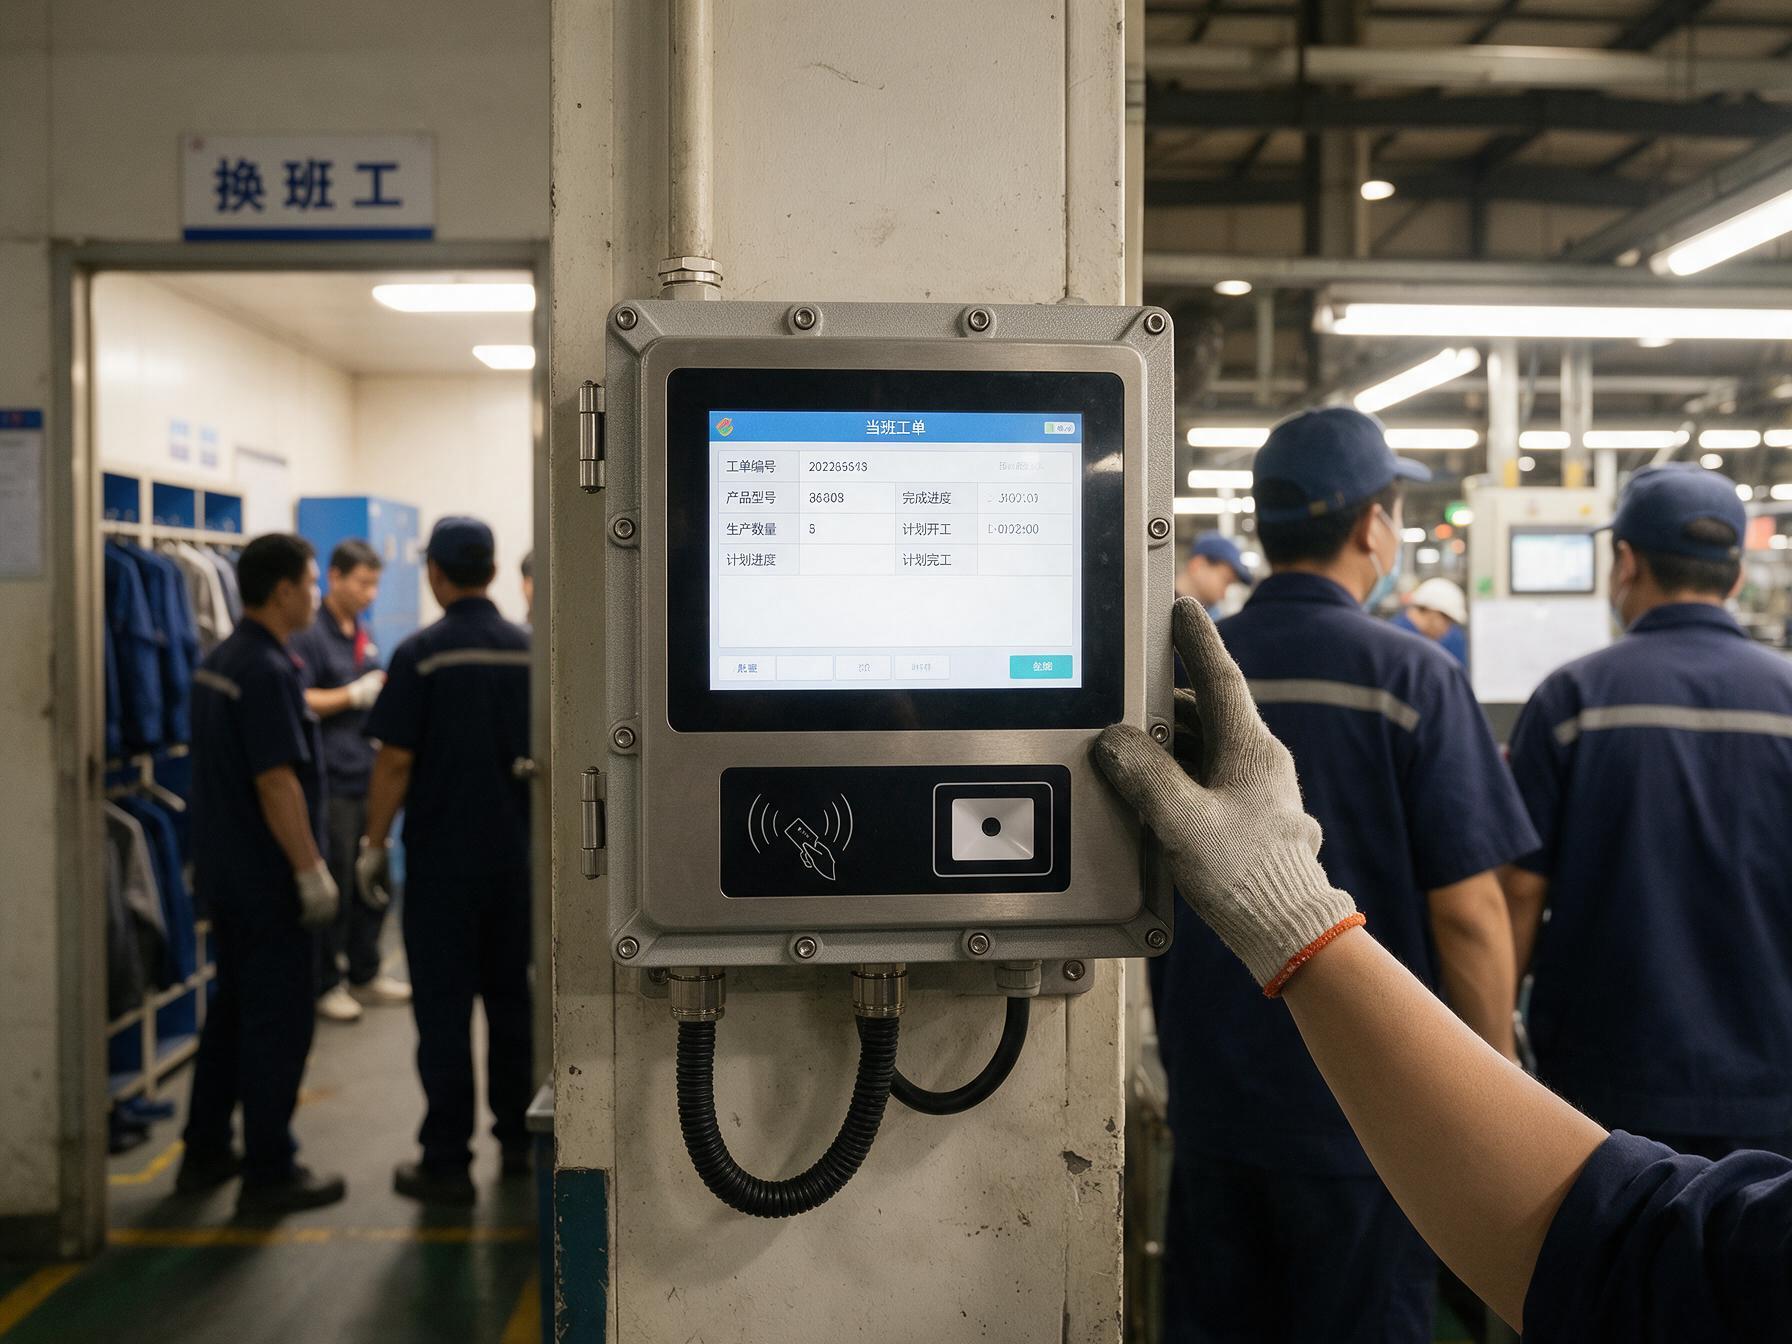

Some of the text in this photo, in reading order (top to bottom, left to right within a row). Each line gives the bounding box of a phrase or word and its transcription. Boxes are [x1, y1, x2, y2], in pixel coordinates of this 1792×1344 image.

[214, 157, 402, 212] 换班工
[866, 419, 926, 436] 当班工单
[726, 459, 777, 474] 工单编号
[726, 491, 777, 505] 产品型号
[902, 491, 952, 505] 完成进度
[726, 522, 777, 536] 生产数量
[902, 523, 952, 536] 计划开工
[726, 553, 777, 567] 计划进度
[902, 553, 952, 567] 计划完工
